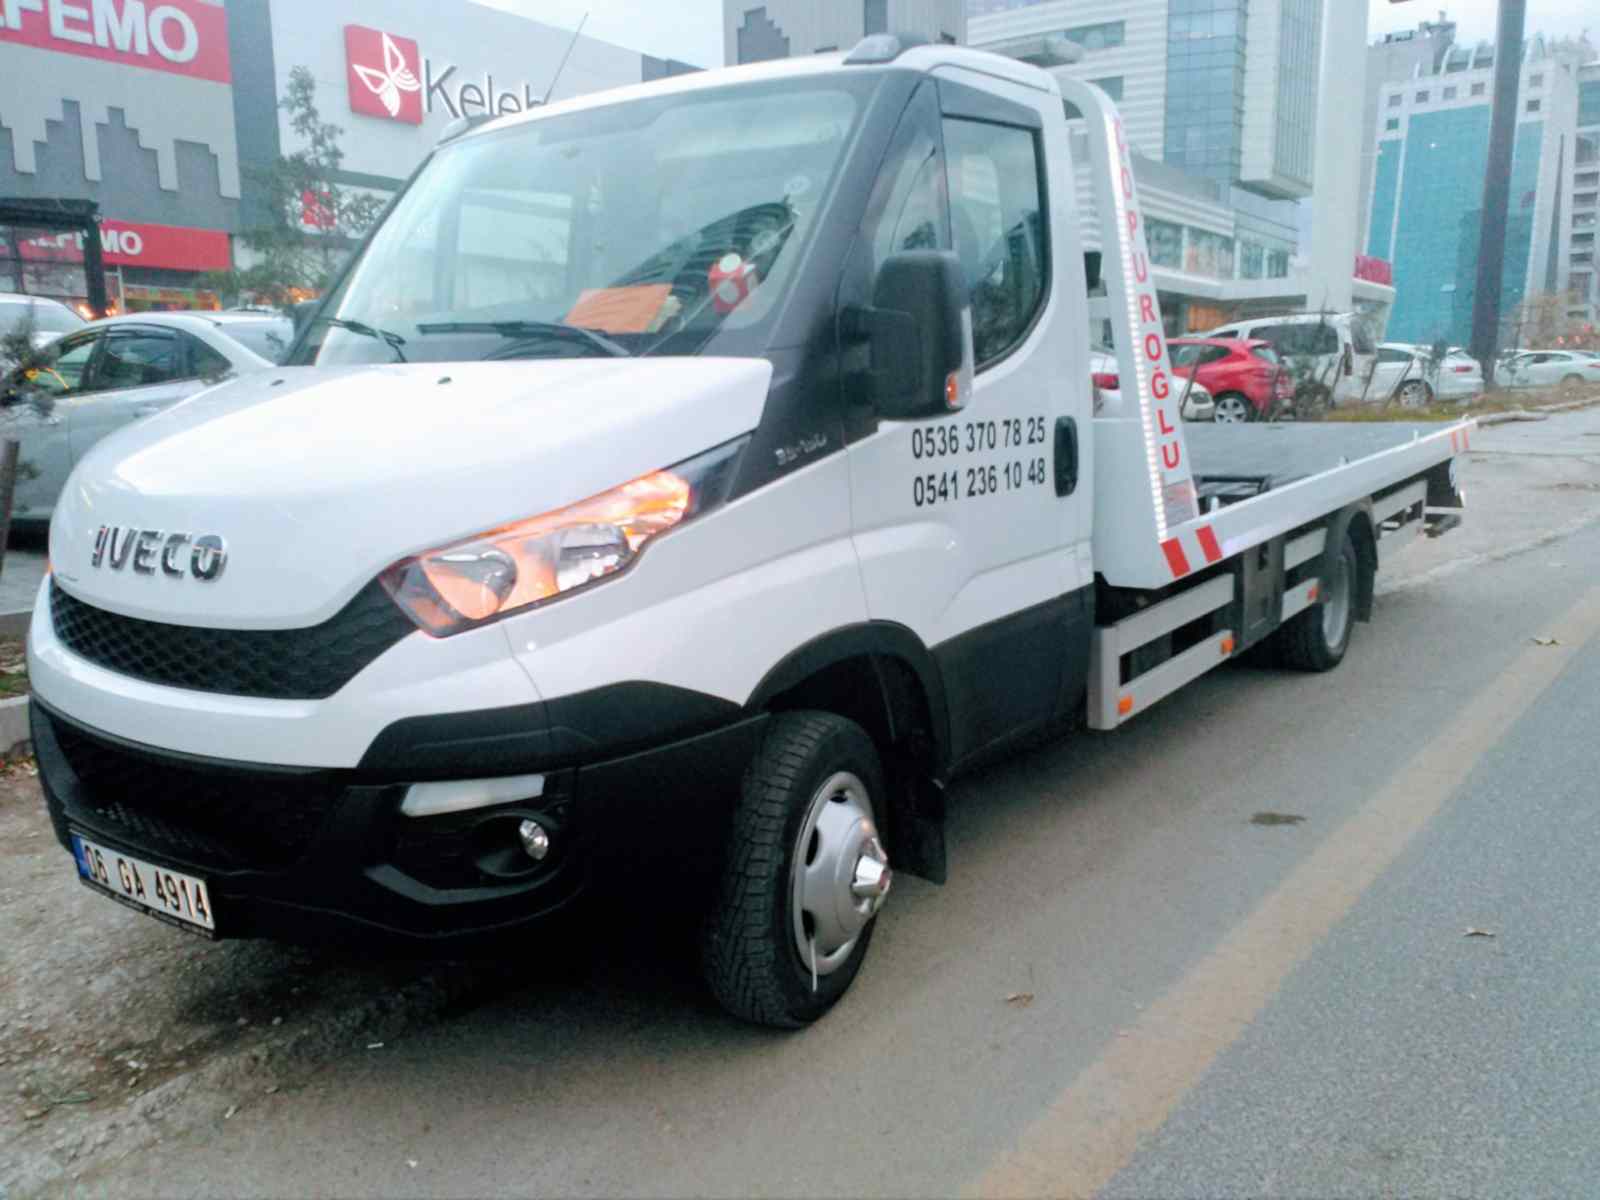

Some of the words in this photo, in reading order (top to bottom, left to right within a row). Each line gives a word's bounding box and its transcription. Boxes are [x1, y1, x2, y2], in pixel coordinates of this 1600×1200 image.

[0, 0, 199, 63] FEMO
[912, 427, 959, 459] 0536
[966, 421, 996, 452] 370
[1003, 418, 1021, 448] 78
[1027, 416, 1045, 444] 25
[913, 470, 958, 507] 0541
[967, 464, 997, 497] 236
[1004, 461, 1022, 490] 10
[1028, 457, 1045, 485] 48
[91, 525, 228, 581] IVECO
[84, 845, 109, 884] 06
[117, 857, 146, 899] GA
[155, 870, 208, 923] 4914
